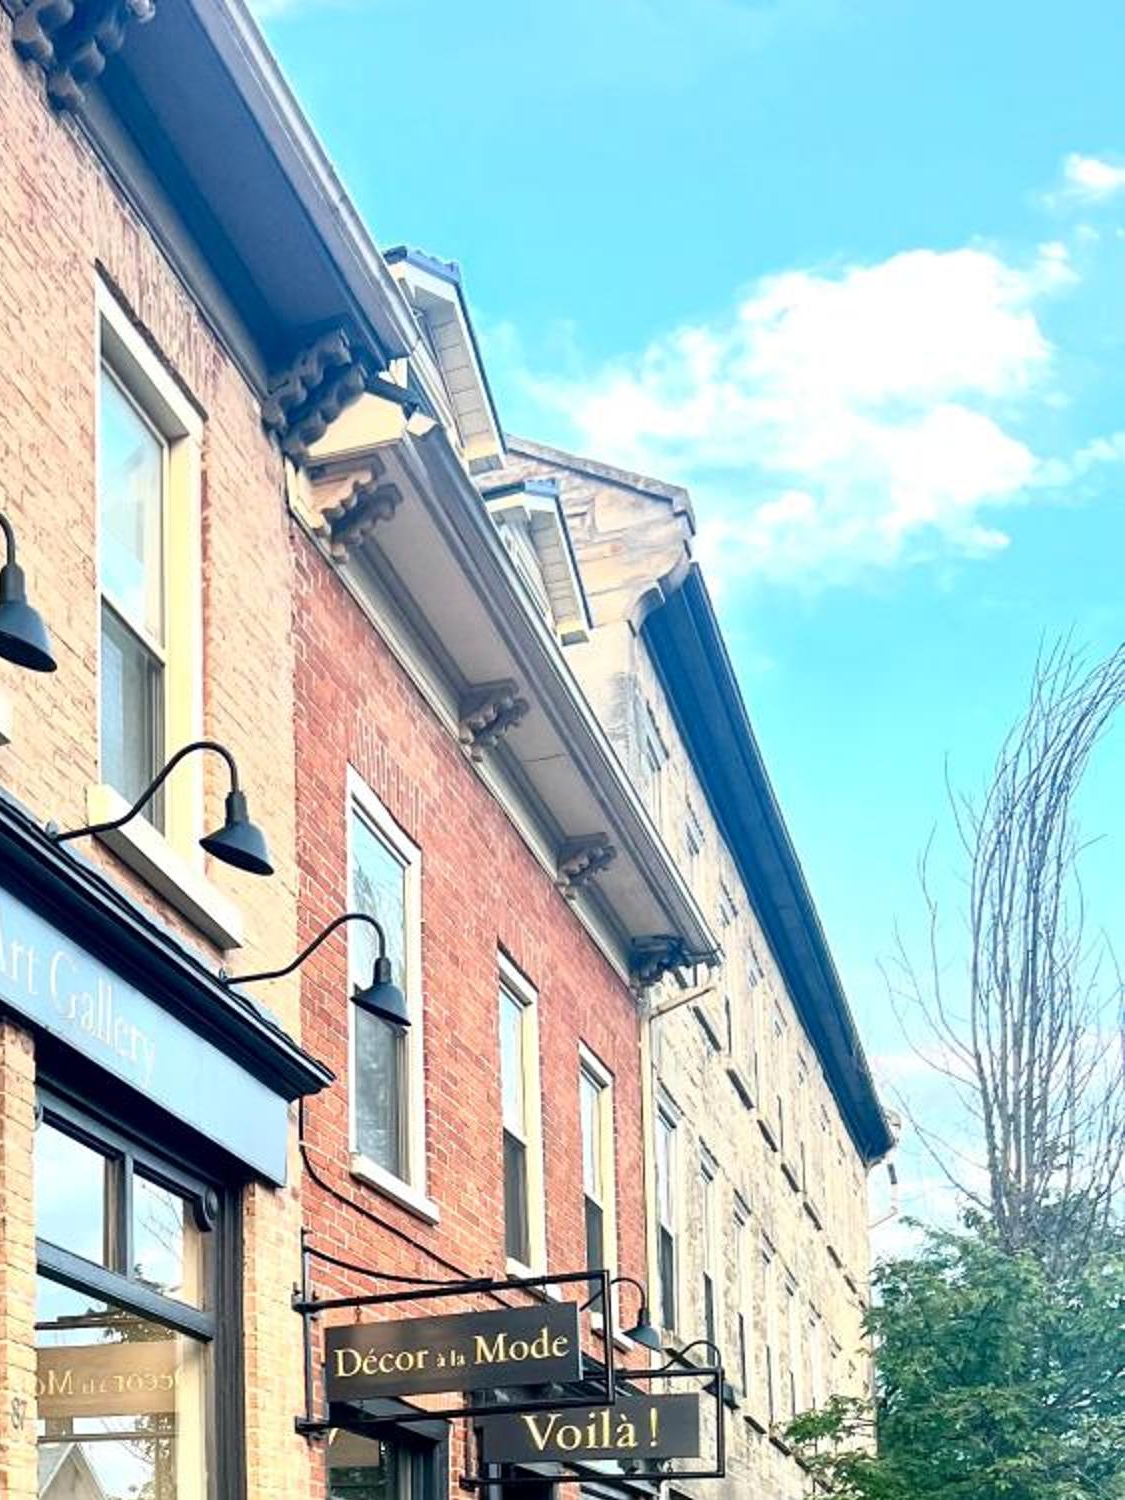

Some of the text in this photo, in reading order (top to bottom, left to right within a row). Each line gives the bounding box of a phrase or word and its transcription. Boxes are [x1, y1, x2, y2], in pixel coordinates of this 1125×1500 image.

[50, 951, 156, 1086] Gallery
[334, 1347, 429, 1377] Décor
[450, 1350, 466, 1367] la
[474, 1327, 569, 1364] Mode
[520, 1408, 638, 1450] Voilà
